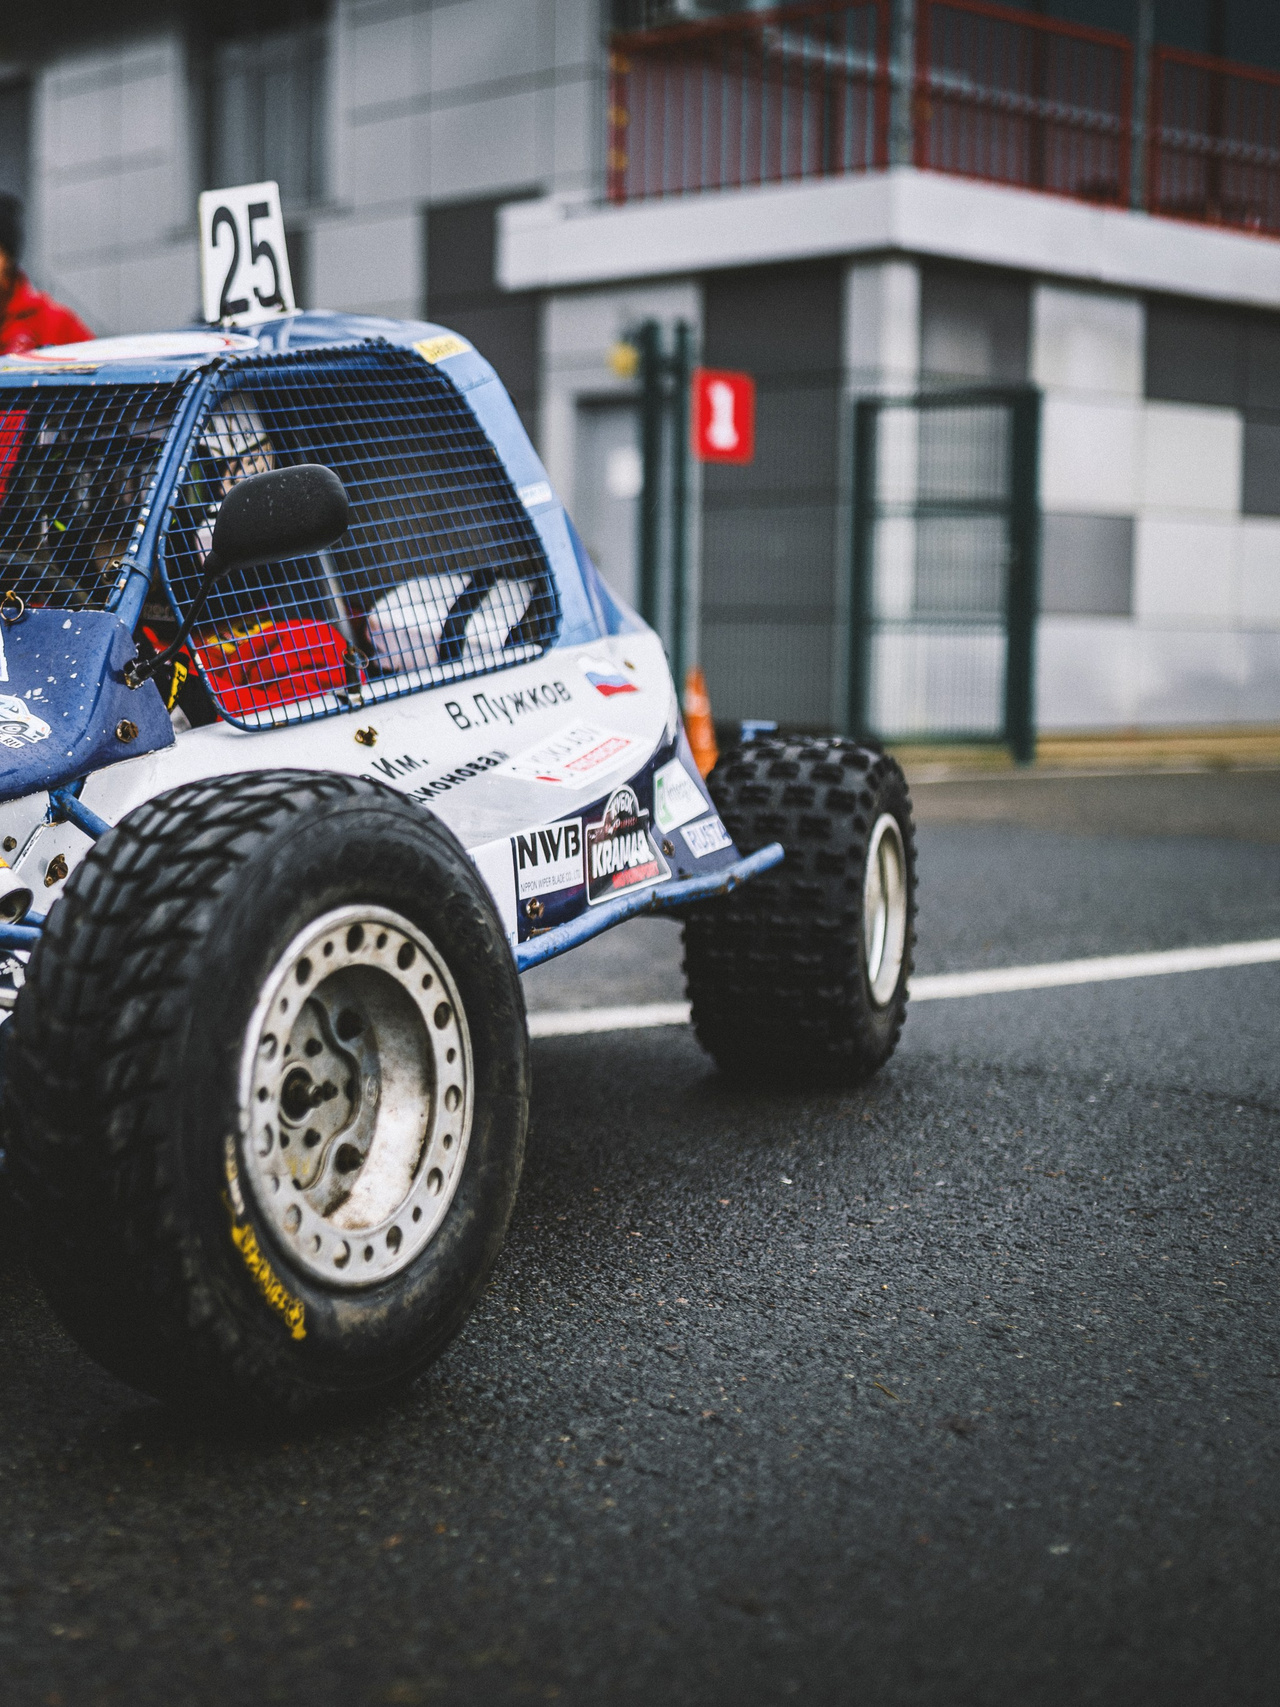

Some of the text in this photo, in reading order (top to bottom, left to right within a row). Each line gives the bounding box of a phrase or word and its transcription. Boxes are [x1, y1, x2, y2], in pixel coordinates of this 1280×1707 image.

[212, 202, 283, 319] 25
[371, 754, 429, 780] Им.
[516, 824, 581, 870] NWB
[591, 829, 655, 879] KRAMAR
